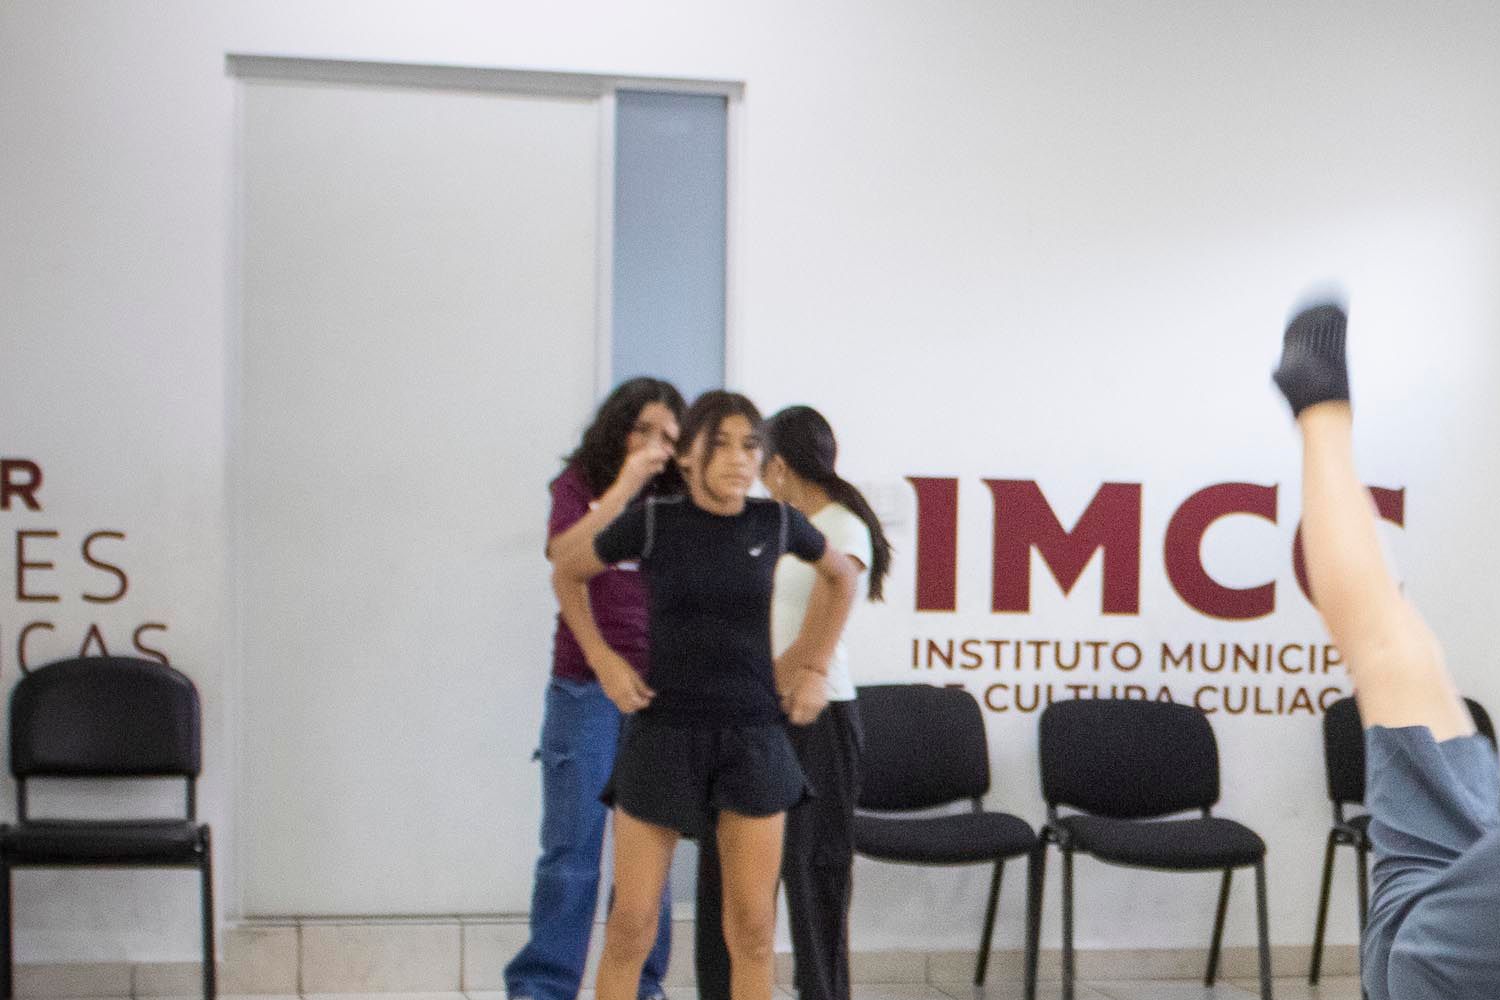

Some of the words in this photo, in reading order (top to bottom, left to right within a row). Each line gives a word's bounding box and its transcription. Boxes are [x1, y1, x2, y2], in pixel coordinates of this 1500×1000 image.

[903, 476, 1406, 621] IMC
[911, 638, 1142, 672] INSTITUTO
[1160, 641, 1350, 675] MUNICIP
[1194, 686, 1343, 715] CULIAC
